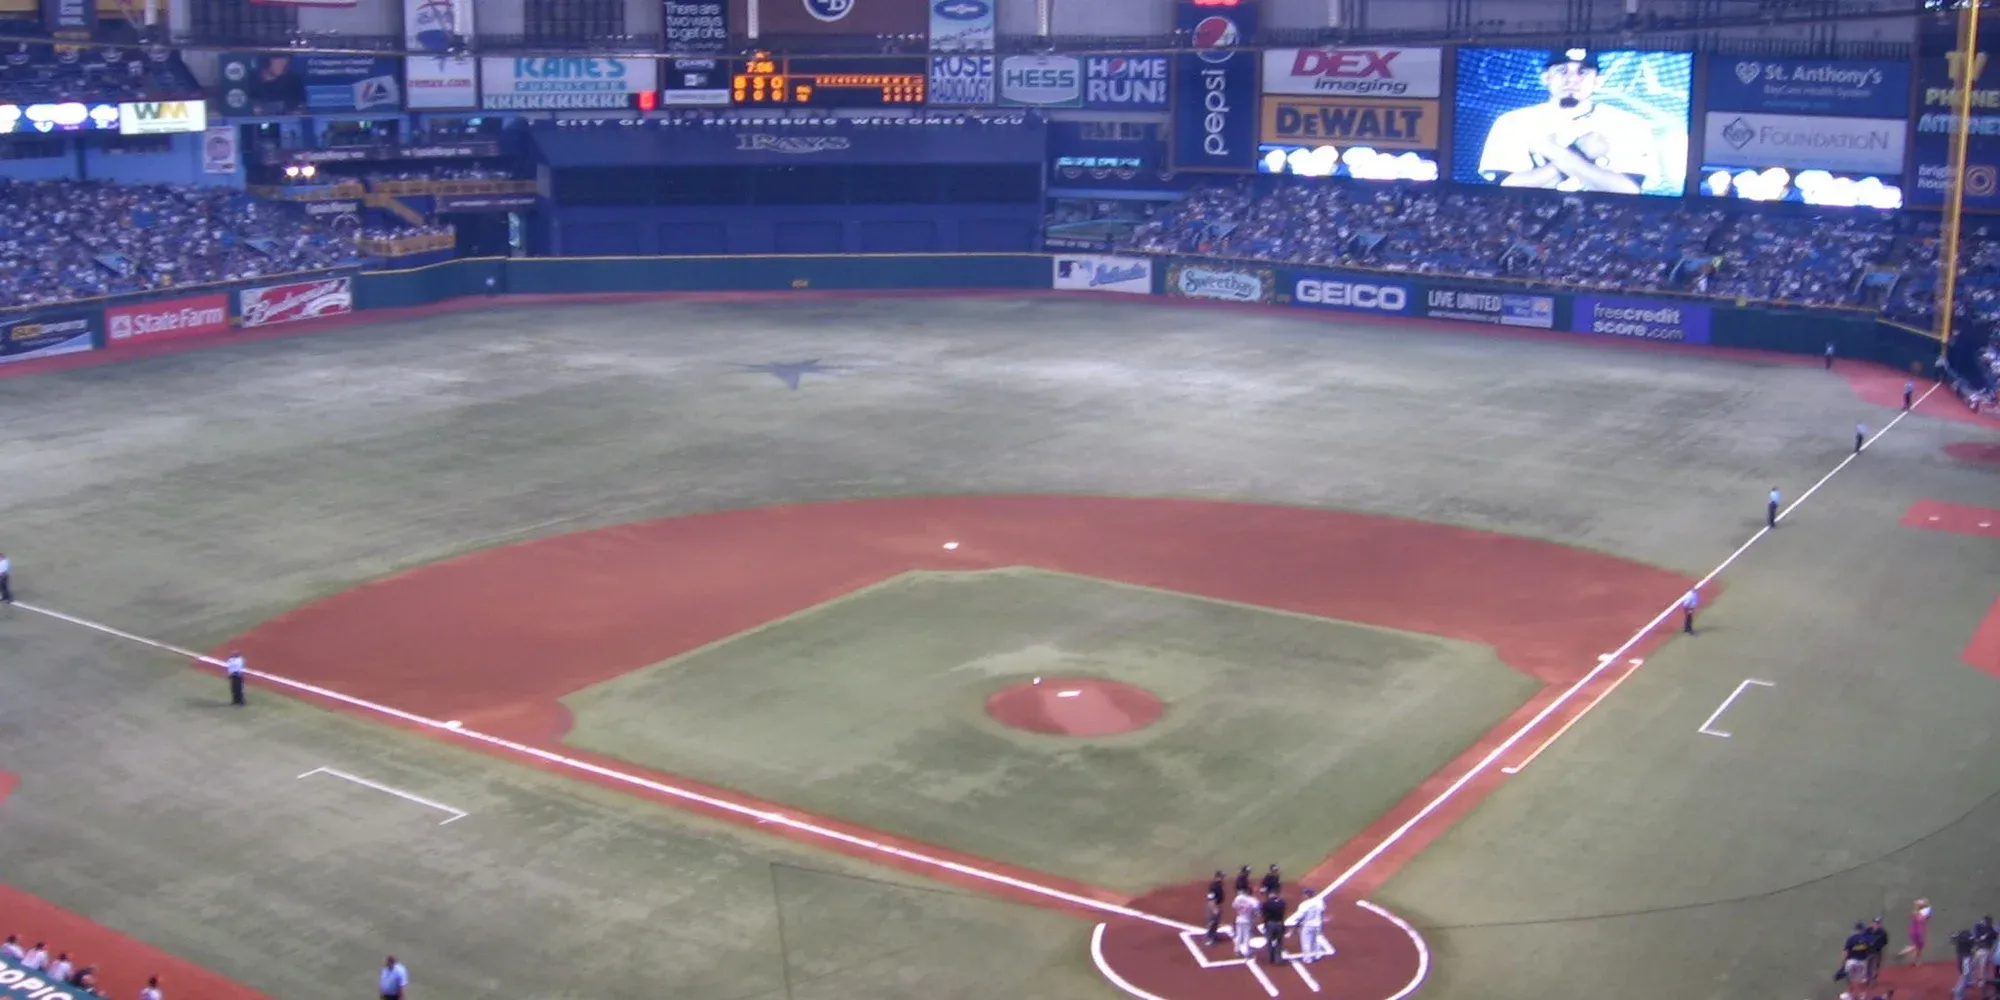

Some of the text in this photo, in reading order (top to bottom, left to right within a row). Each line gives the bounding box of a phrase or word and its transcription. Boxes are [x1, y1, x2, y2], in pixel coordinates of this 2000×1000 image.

[664, 1, 720, 15] There are
[679, 28, 699, 41] get
[931, 55, 992, 77] ROSE
[1087, 58, 1168, 79] HOME
[1290, 50, 1402, 79] DEX
[1005, 69, 1075, 88] HESS
[1314, 78, 1408, 95] imaging
[1764, 64, 1883, 89] St. Anthony's
[1088, 79, 1167, 103] RUN!
[133, 102, 190, 120] WM
[555, 116, 1024, 127] CITY OF ST. PETERSBURG WELCOMES YOU
[1201, 68, 1231, 156] pepsi
[1296, 279, 1407, 310] GEICO
[1427, 289, 1455, 308] LIVE
[1456, 293, 1501, 312] UNITED
[1593, 302, 1681, 325] freecredit
[1593, 320, 1684, 340] score.com
